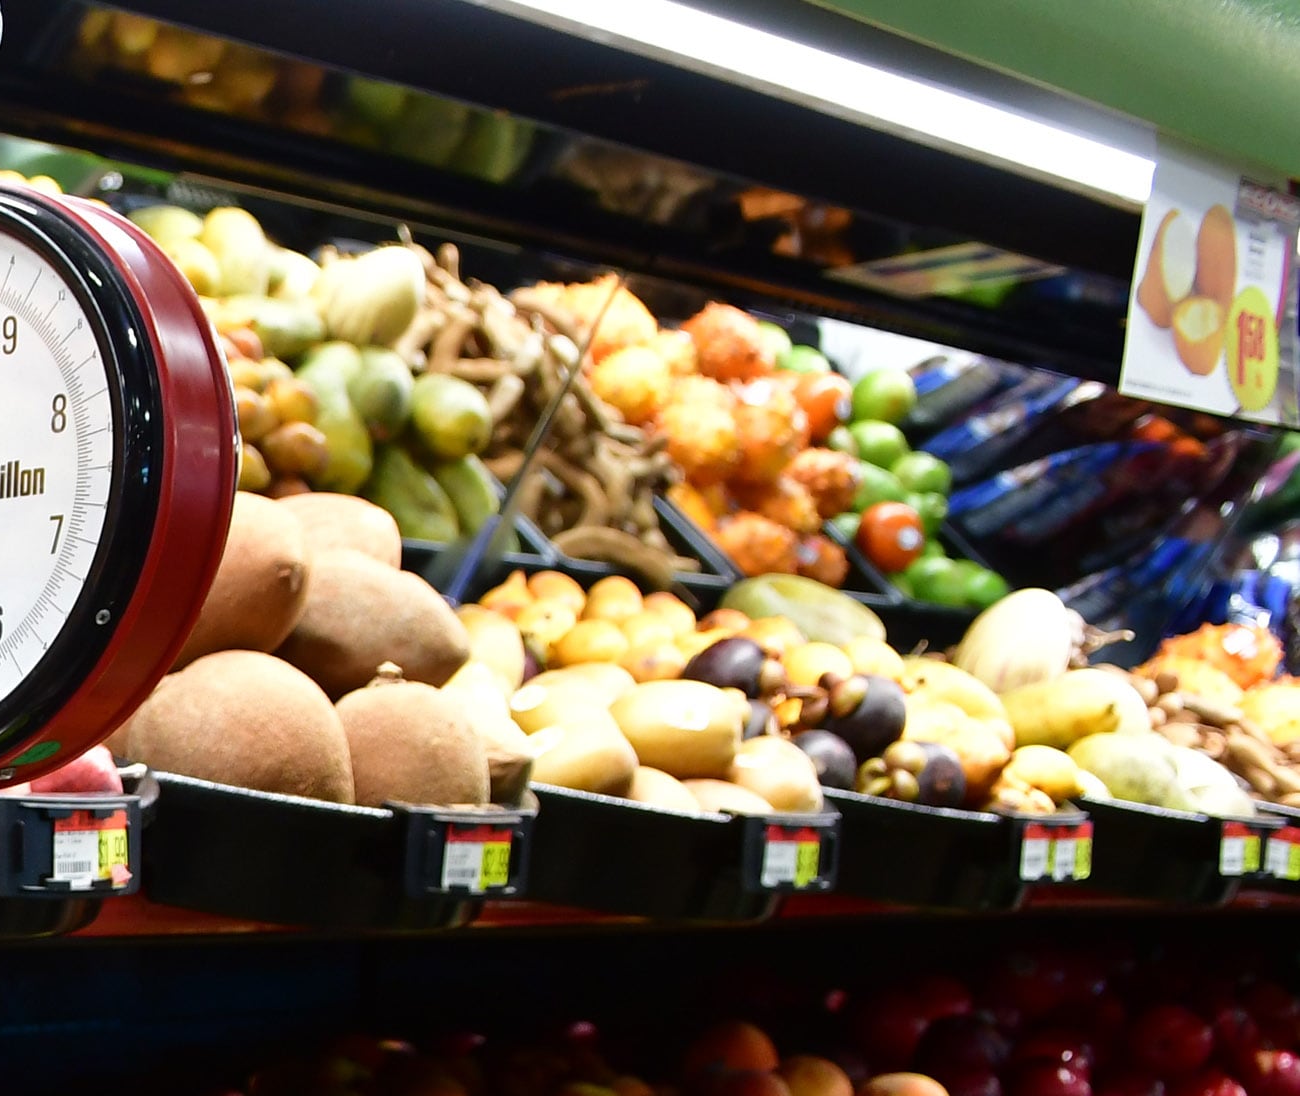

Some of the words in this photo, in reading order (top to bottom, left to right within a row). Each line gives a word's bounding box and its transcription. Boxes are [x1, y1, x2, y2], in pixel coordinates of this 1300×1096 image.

[2, 315, 17, 355] 9
[51, 393, 67, 434] 8
[50, 514, 64, 554] 7
